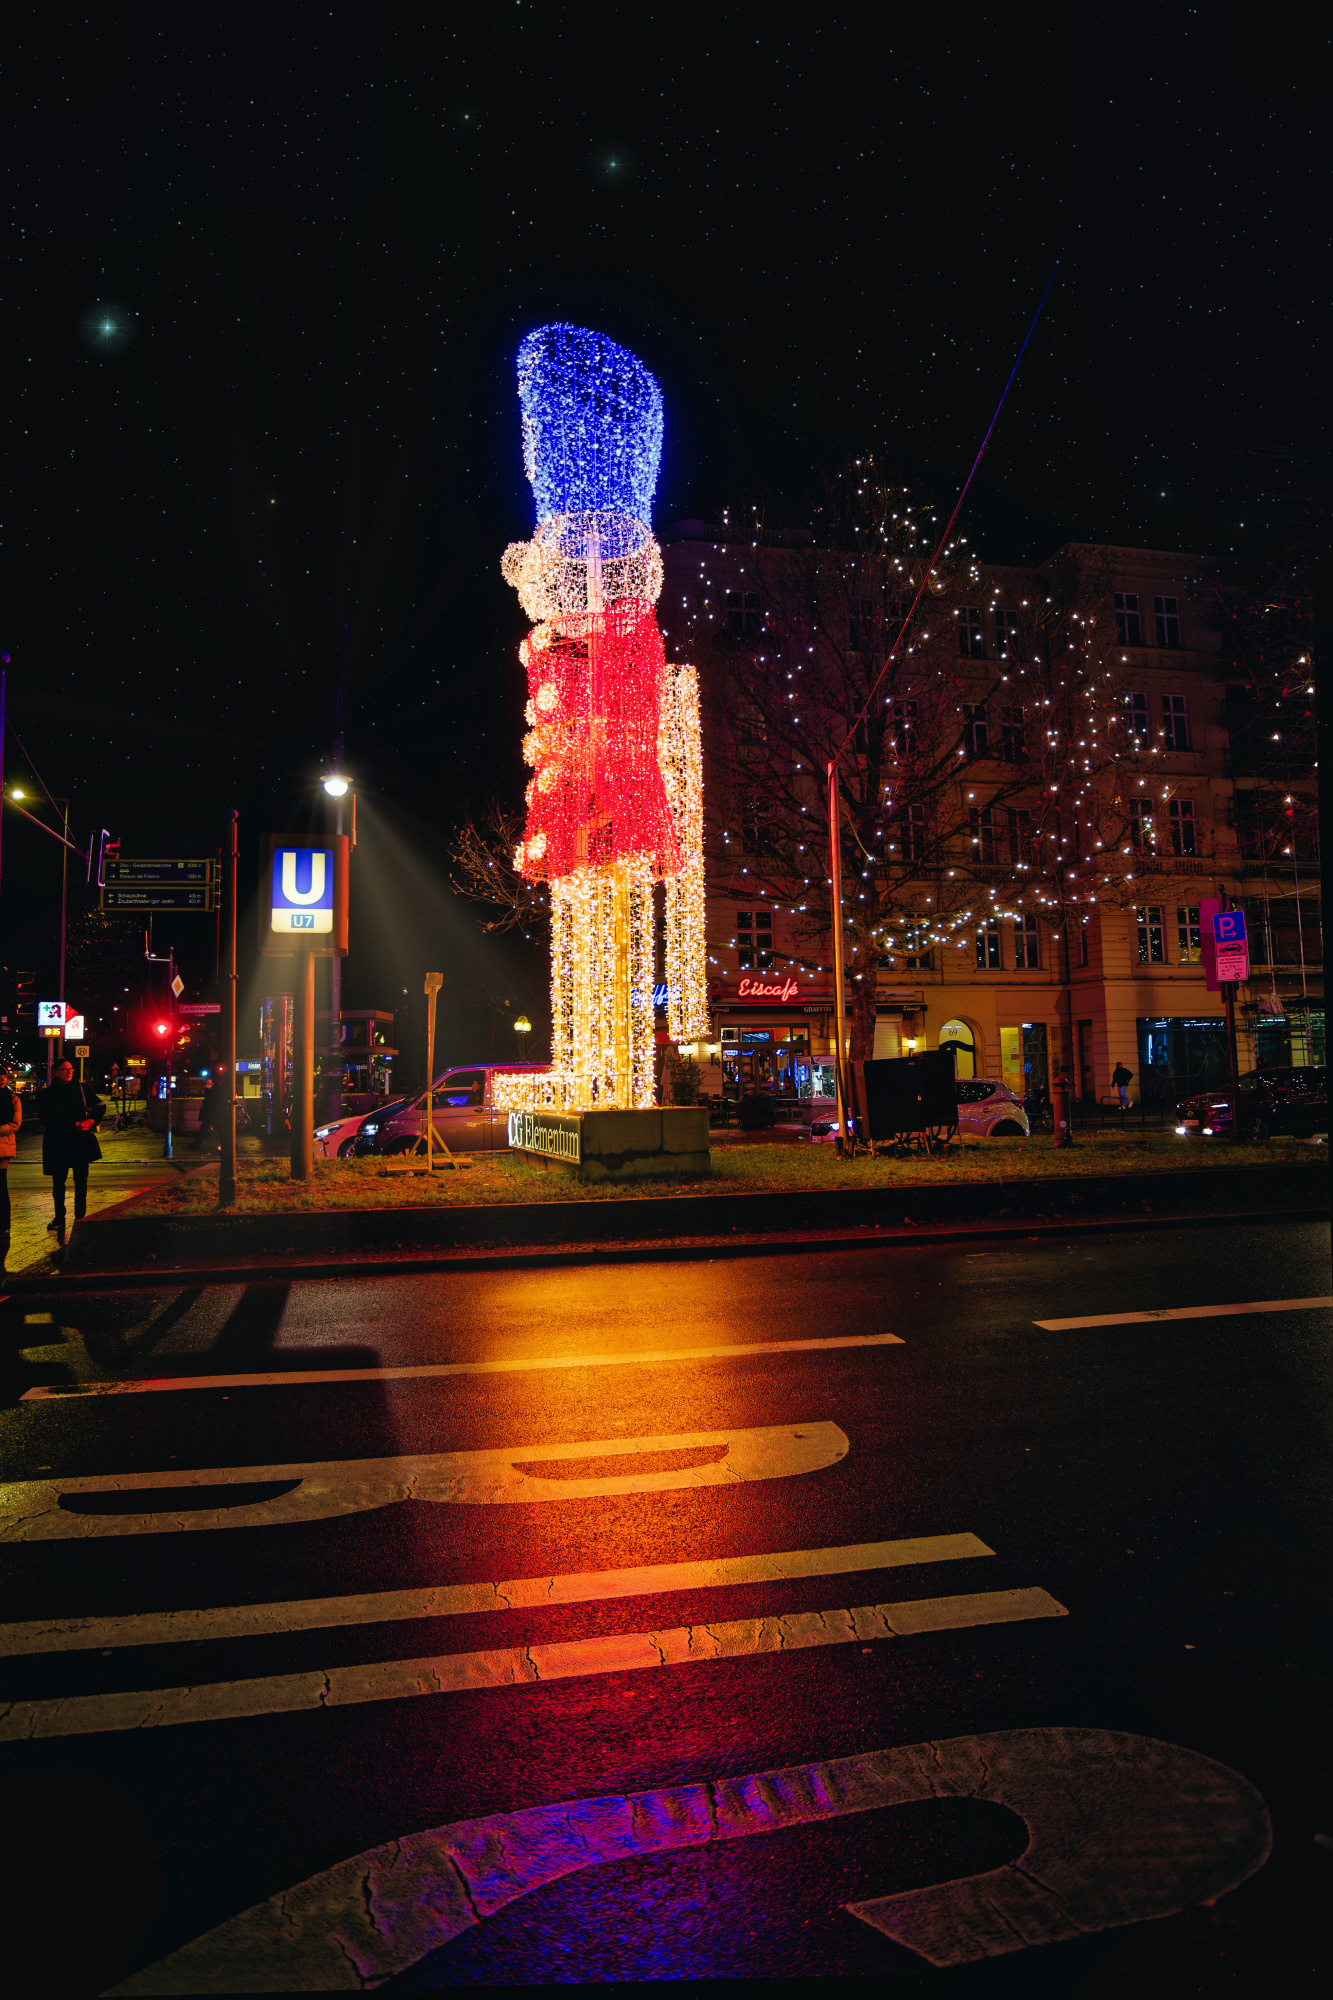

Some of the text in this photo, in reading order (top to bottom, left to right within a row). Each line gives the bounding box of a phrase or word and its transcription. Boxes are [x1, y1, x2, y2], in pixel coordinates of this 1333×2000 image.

[282, 852, 325, 905] U
[293, 915, 313, 927] U7
[1218, 916, 1235, 939] P
[738, 977, 799, 1002] Eiscafé
[948, 1028, 958, 1037] 69
[509, 1110, 580, 1159] CG Elementum
